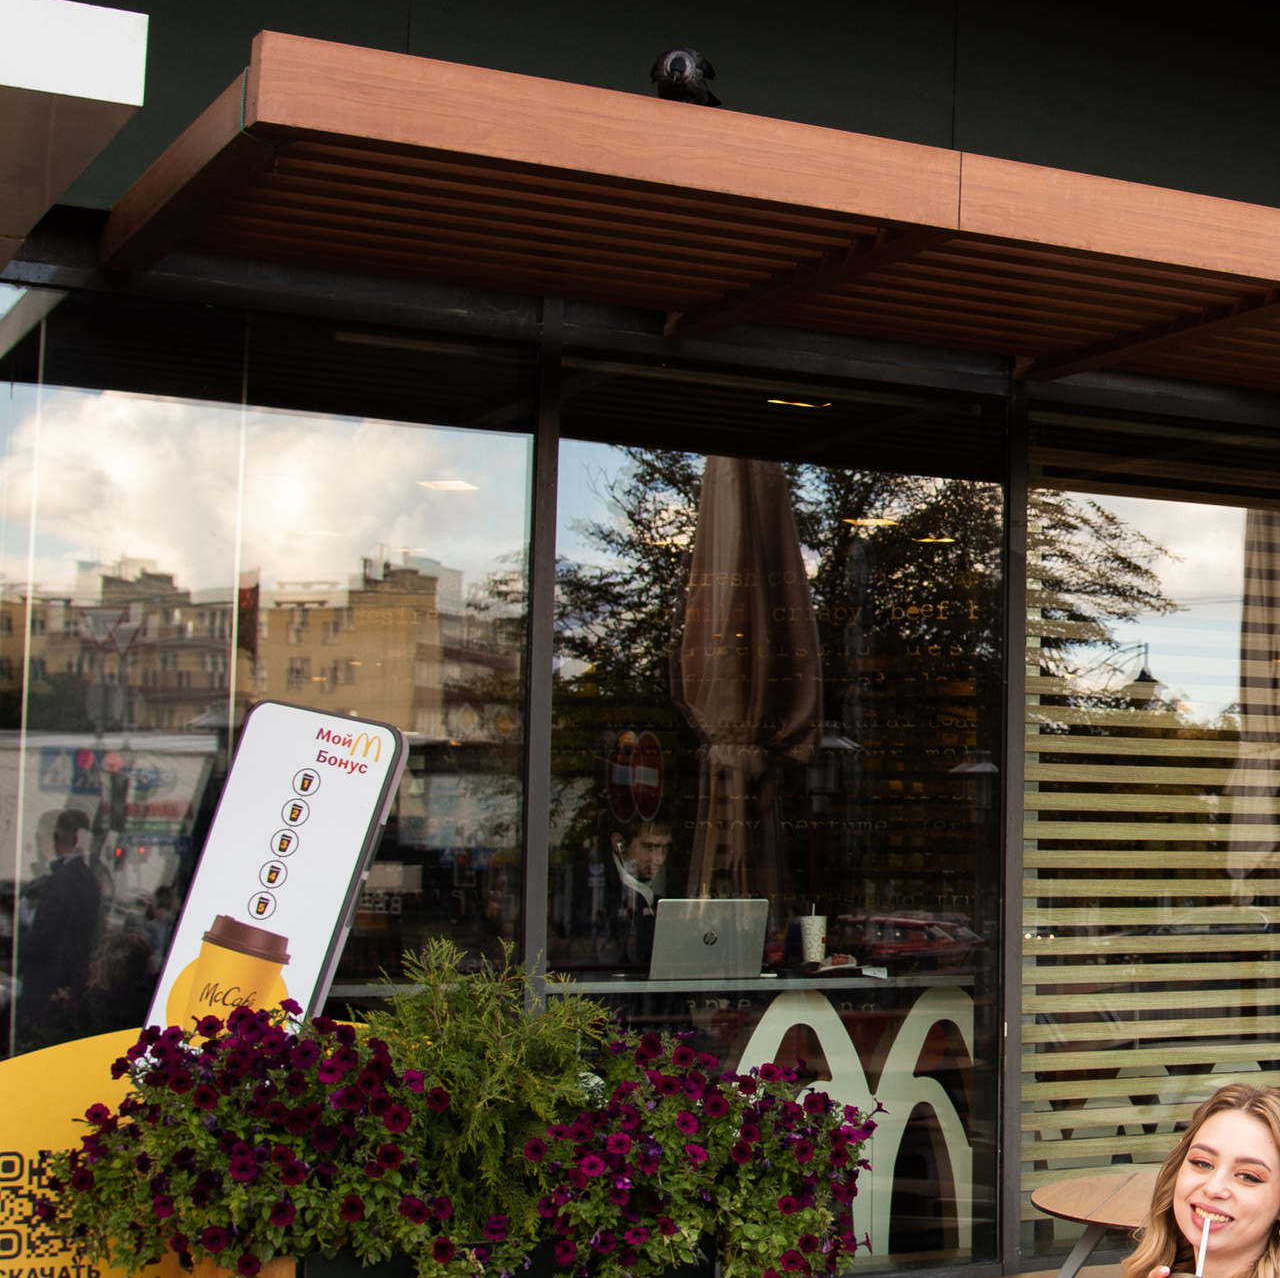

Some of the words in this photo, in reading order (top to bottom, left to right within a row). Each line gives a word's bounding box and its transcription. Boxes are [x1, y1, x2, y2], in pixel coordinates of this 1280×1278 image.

[890, 600, 949, 621] beef
[315, 728, 352, 748] Мой
[316, 749, 369, 775] Бонус
